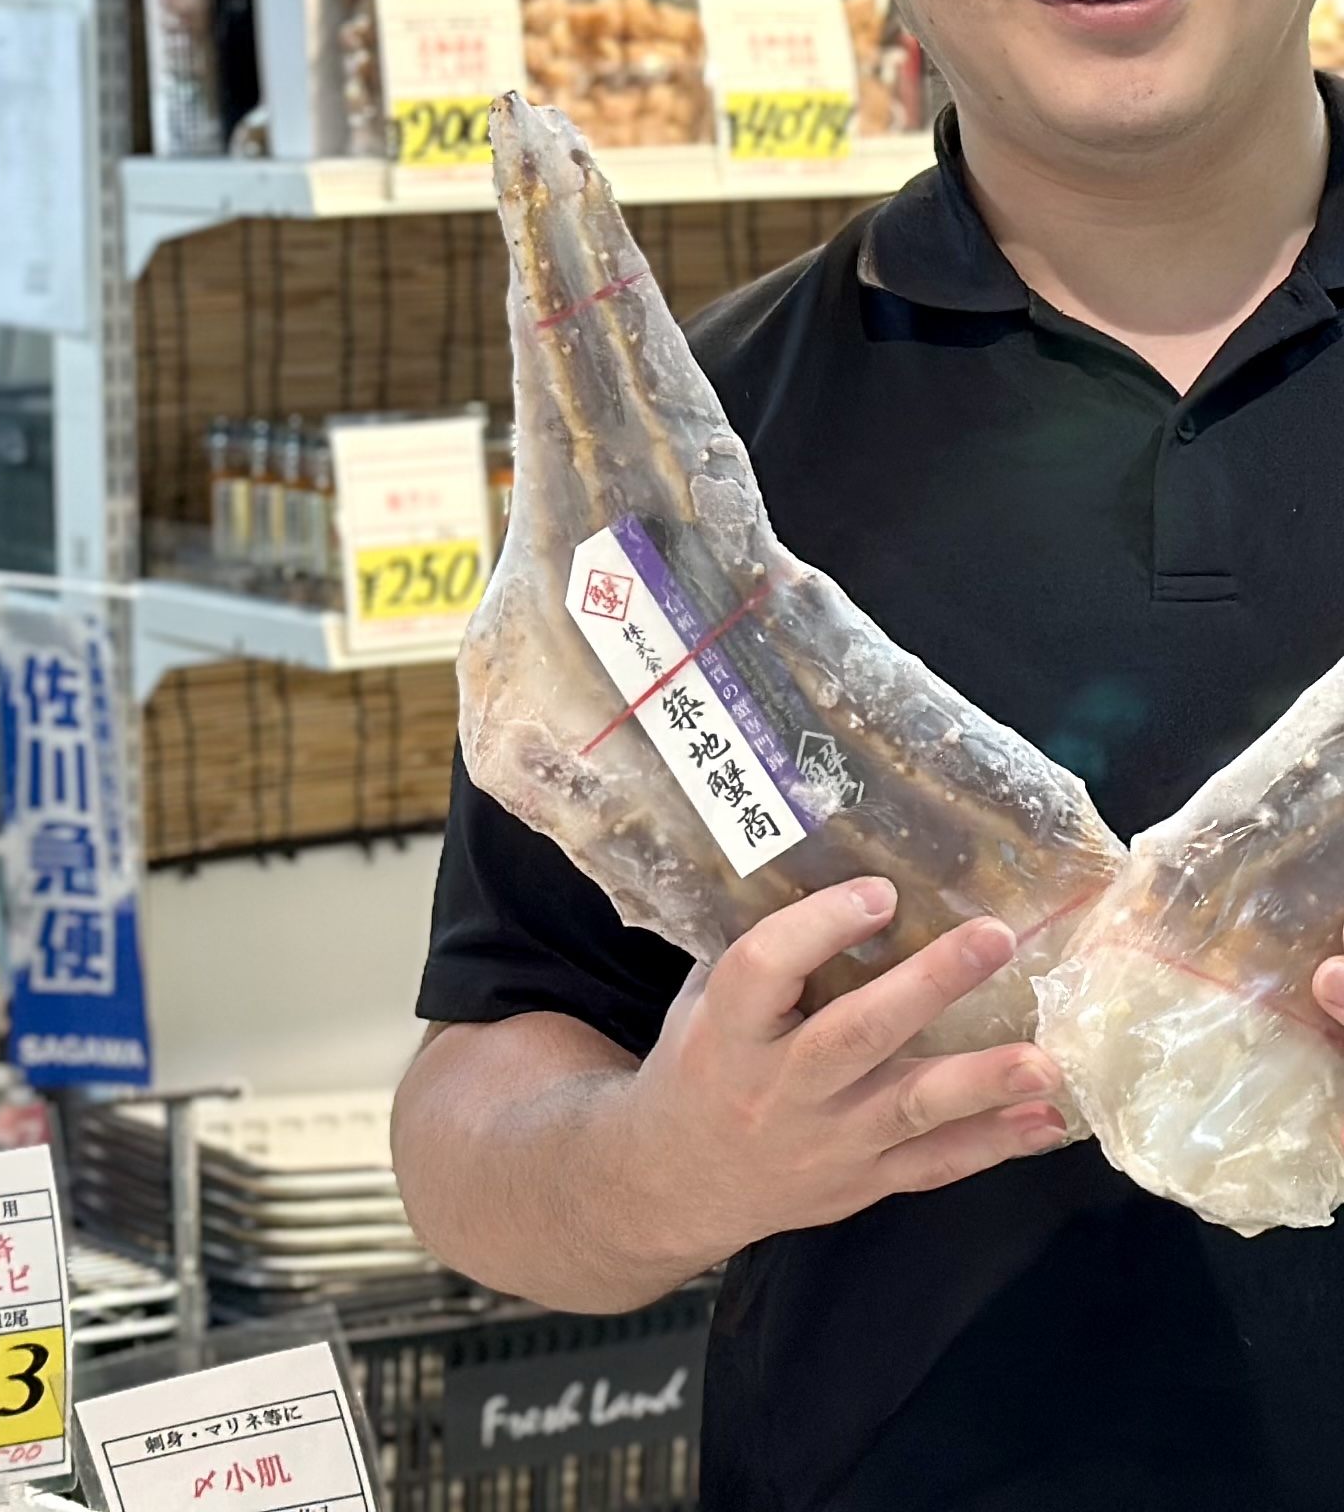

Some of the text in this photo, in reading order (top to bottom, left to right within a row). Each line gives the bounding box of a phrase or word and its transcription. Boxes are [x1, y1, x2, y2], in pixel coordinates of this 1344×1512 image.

[23, 651, 109, 985] 佐川急便
[19, 1033, 146, 1069] SAGAWA
